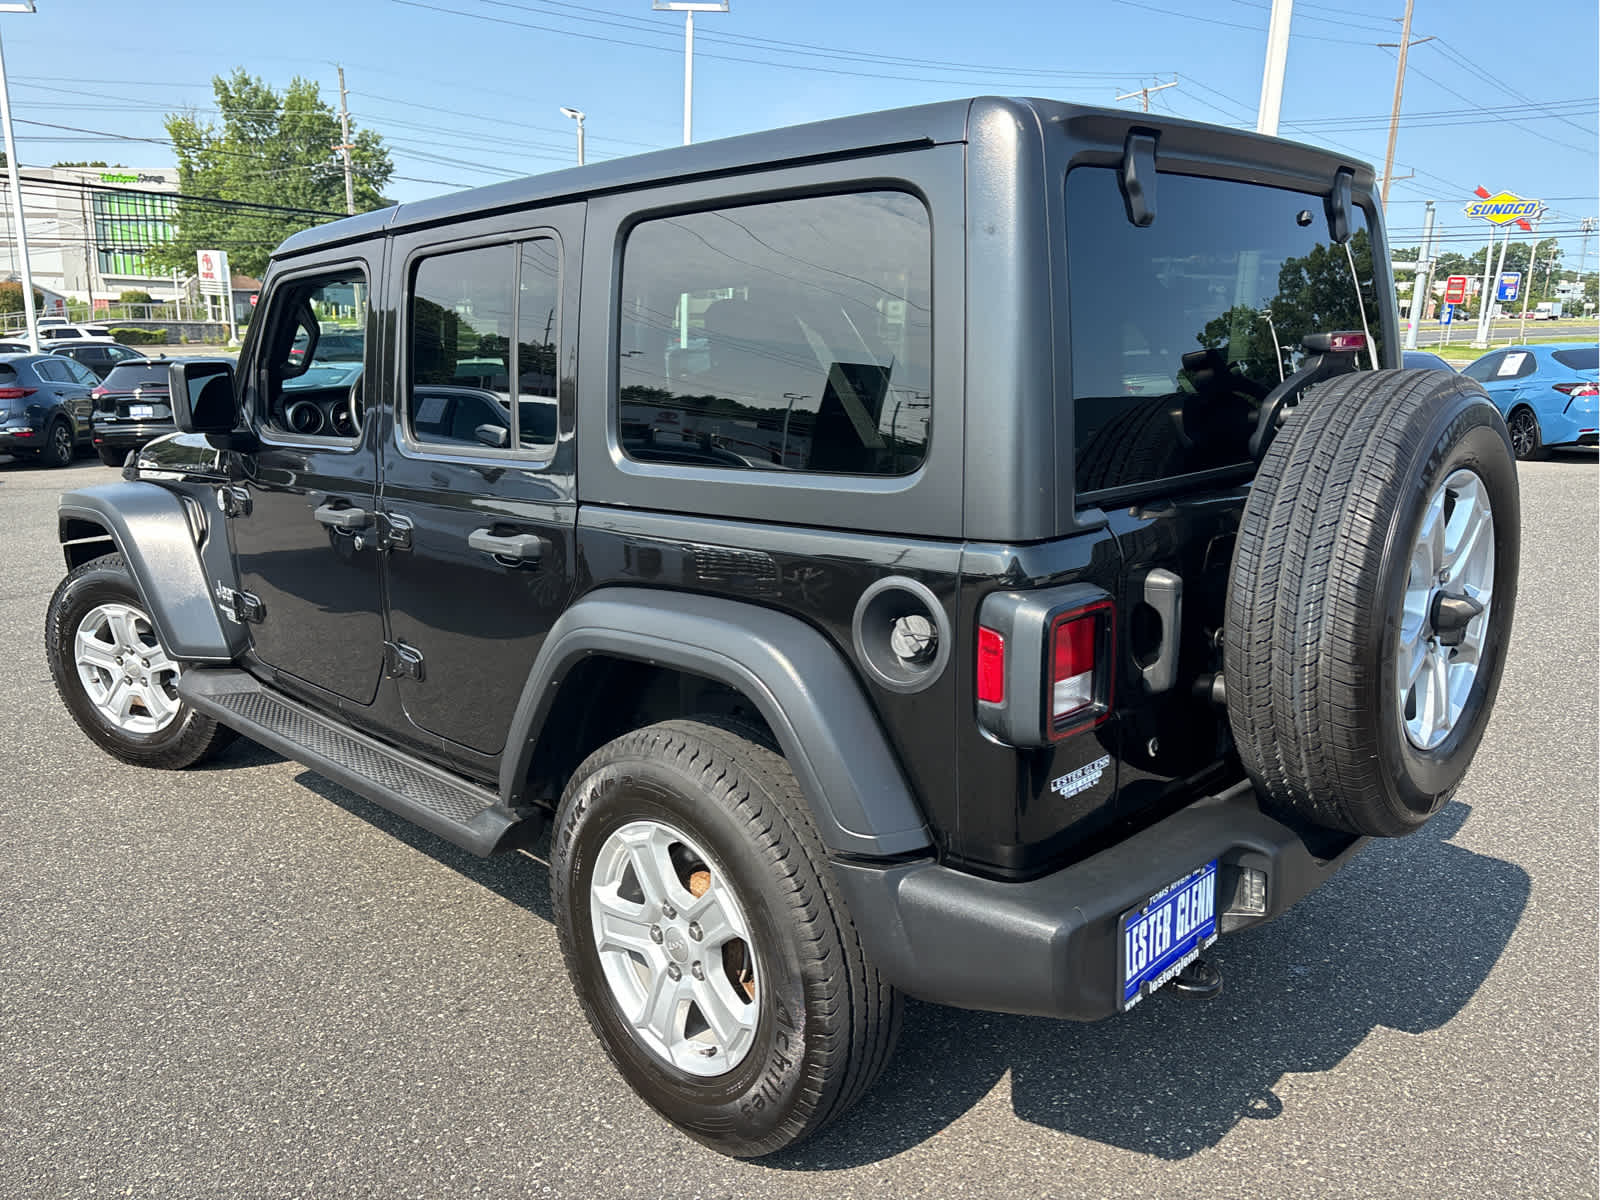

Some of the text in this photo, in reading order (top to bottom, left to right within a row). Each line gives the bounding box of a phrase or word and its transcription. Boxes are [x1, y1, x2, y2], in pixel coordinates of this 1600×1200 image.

[1469, 203, 1537, 215] SUNOCO
[1051, 767, 1082, 793] LESTER
[1083, 754, 1110, 777] GLENN
[1125, 871, 1216, 982] LESTER GLENN
[740, 995, 797, 1119] Achilles
